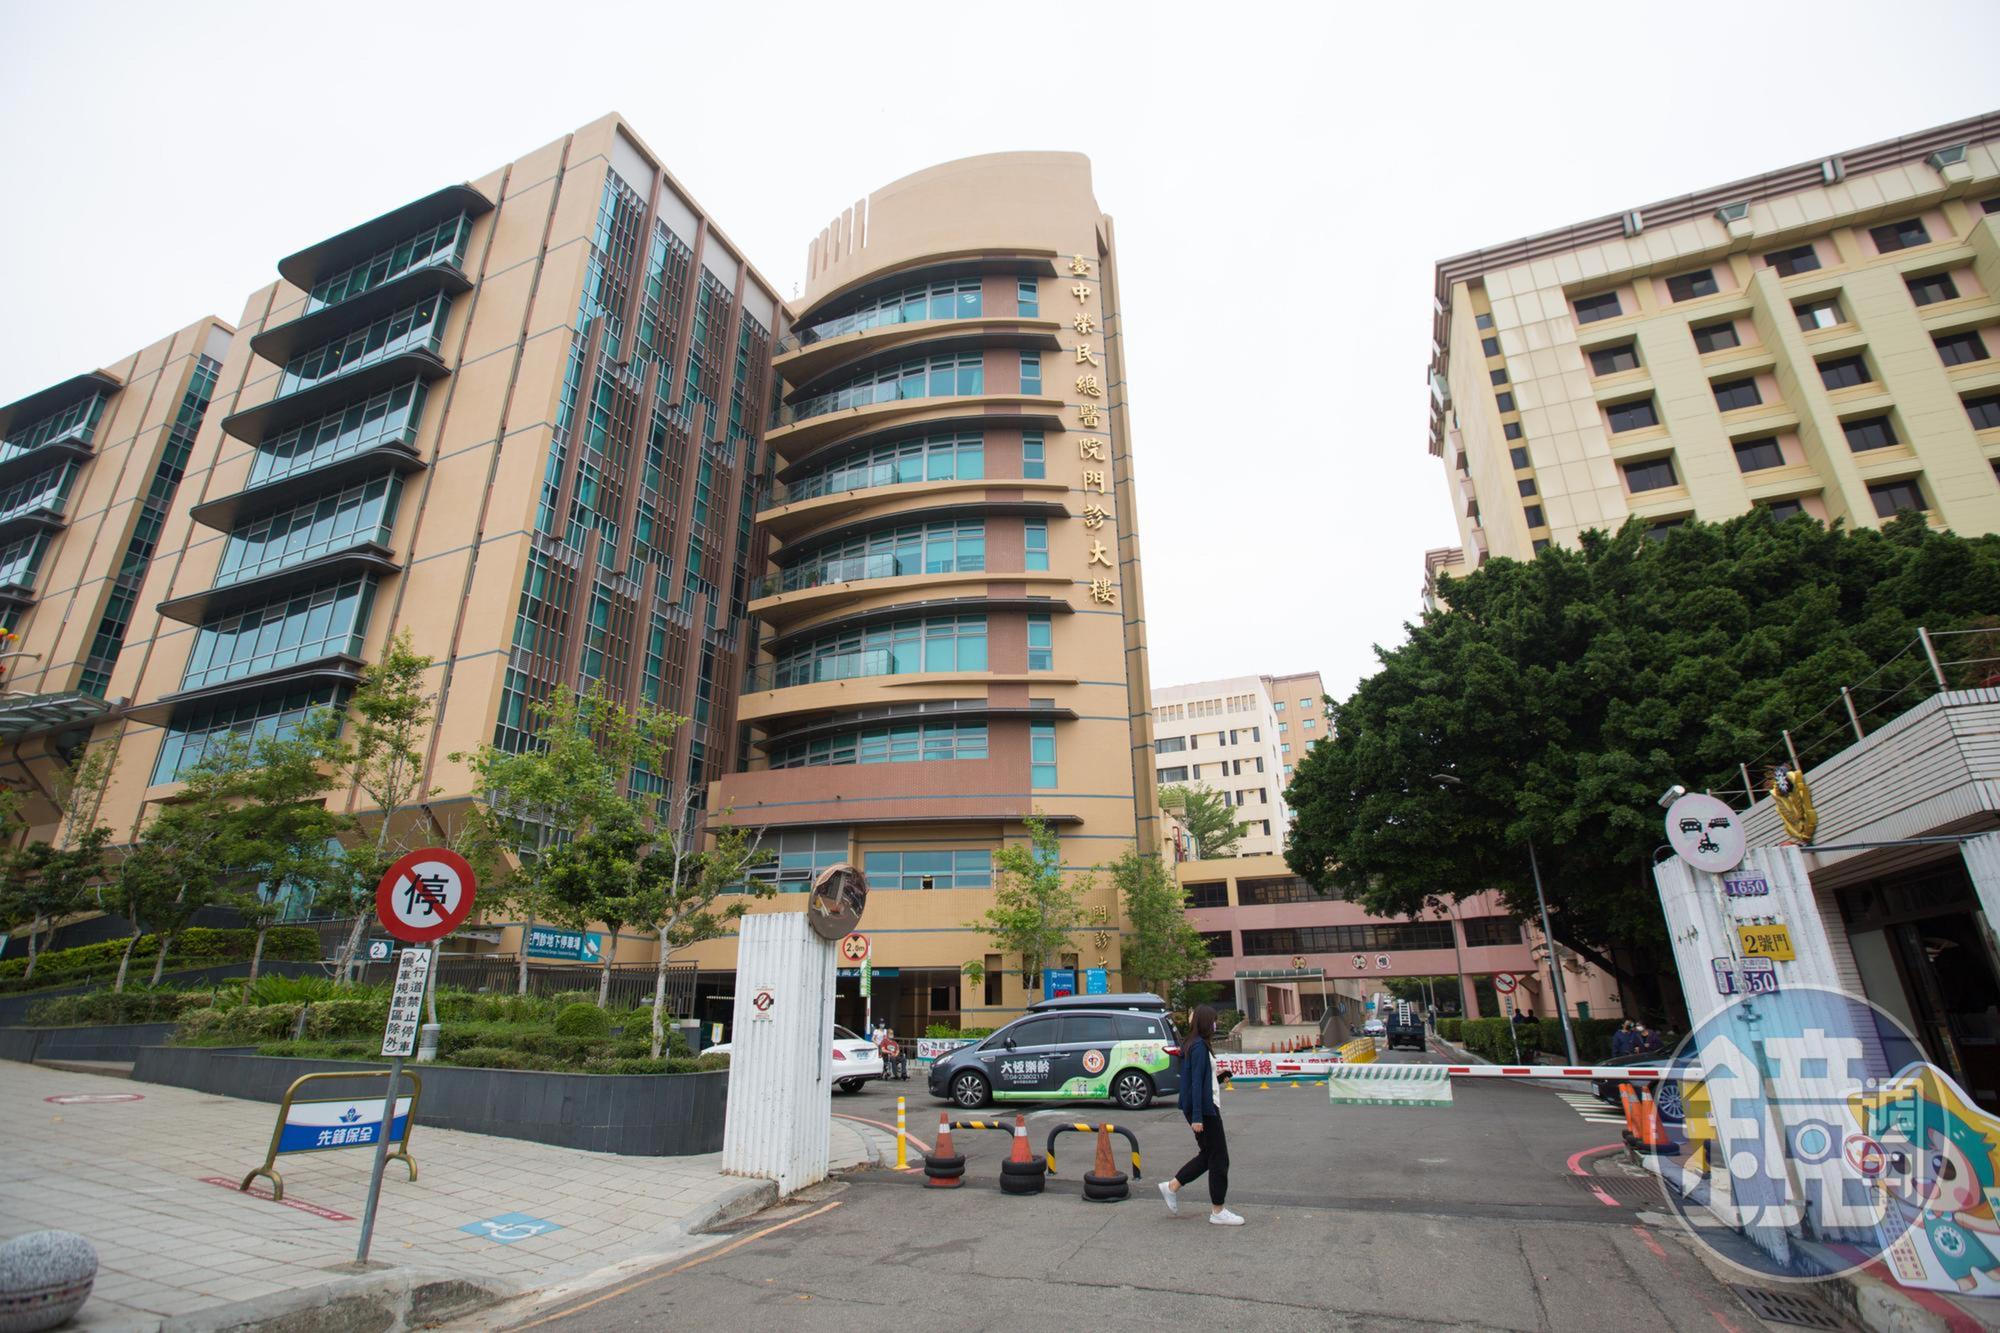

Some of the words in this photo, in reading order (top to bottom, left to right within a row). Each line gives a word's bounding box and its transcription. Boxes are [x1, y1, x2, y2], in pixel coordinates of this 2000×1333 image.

[1068, 254, 1117, 605] 臺中榮民總醫院門診大樓
[404, 873, 450, 915] 停
[1728, 881, 1767, 894] 1650
[1744, 933, 1790, 954] 2號門
[398, 952, 428, 1053] 人行道禁止停車
[316, 1126, 373, 1146] 先鋒保全
